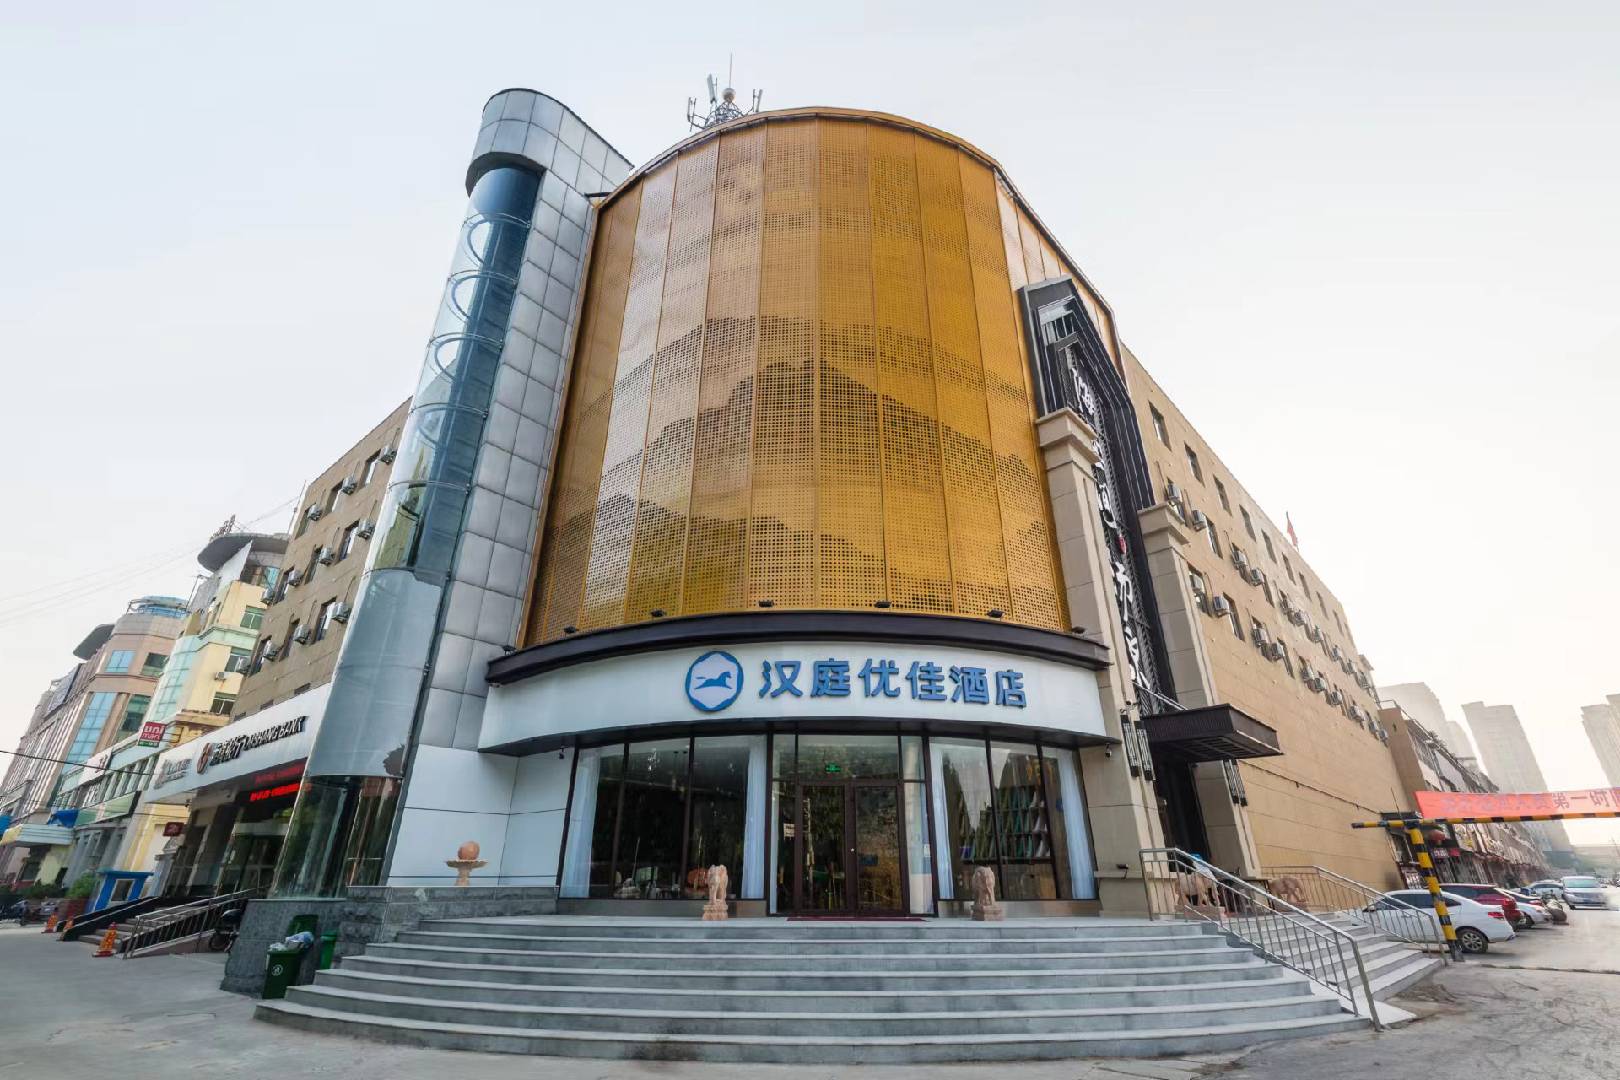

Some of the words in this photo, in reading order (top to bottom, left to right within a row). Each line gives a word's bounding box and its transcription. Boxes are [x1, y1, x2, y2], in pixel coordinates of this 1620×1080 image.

[758, 657, 1027, 708] 汉庭优佳酒店
